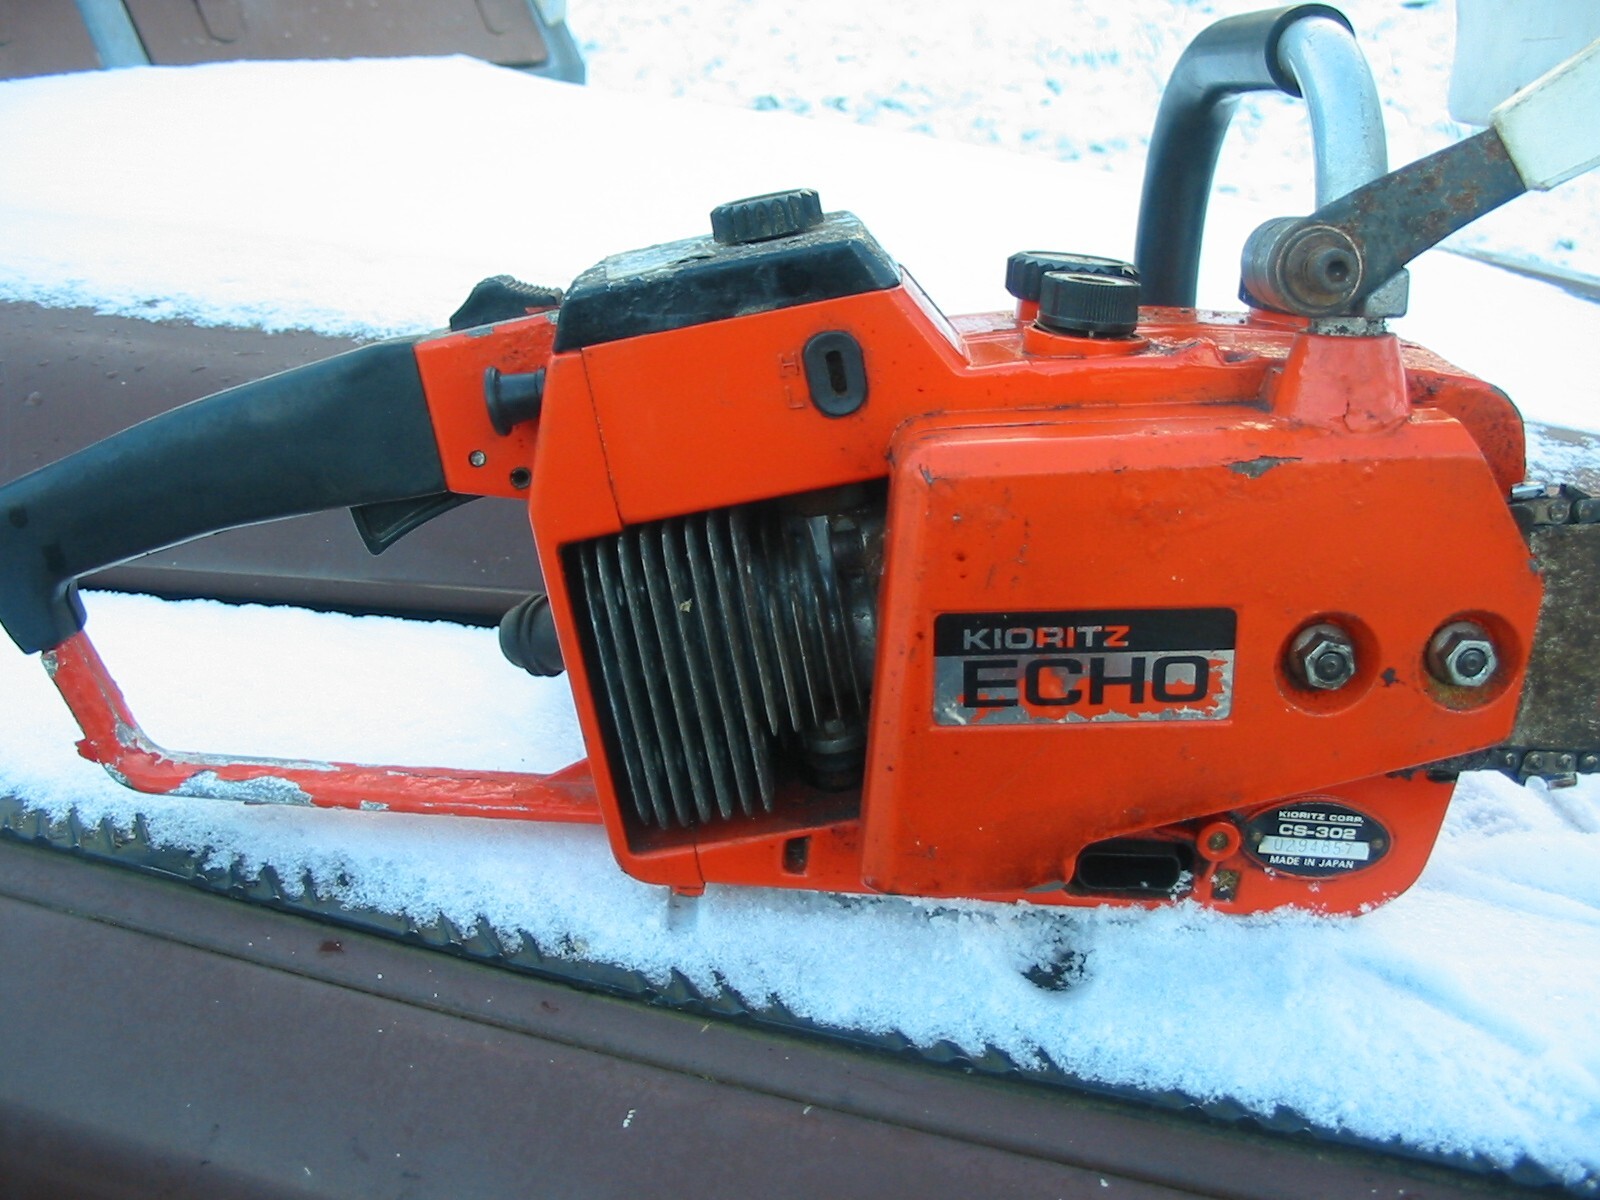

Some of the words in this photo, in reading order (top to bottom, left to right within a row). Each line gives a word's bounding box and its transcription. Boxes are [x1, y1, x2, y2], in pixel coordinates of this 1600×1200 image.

[963, 625, 1130, 649] KIORITZ
[962, 656, 1210, 708] ECHO
[1278, 810, 1326, 821] KIORITZ
[1278, 824, 1357, 840] CS-302
[1269, 856, 1301, 866] MADE
[1303, 858, 1316, 867] IN
[1318, 859, 1355, 869] JAPAN
